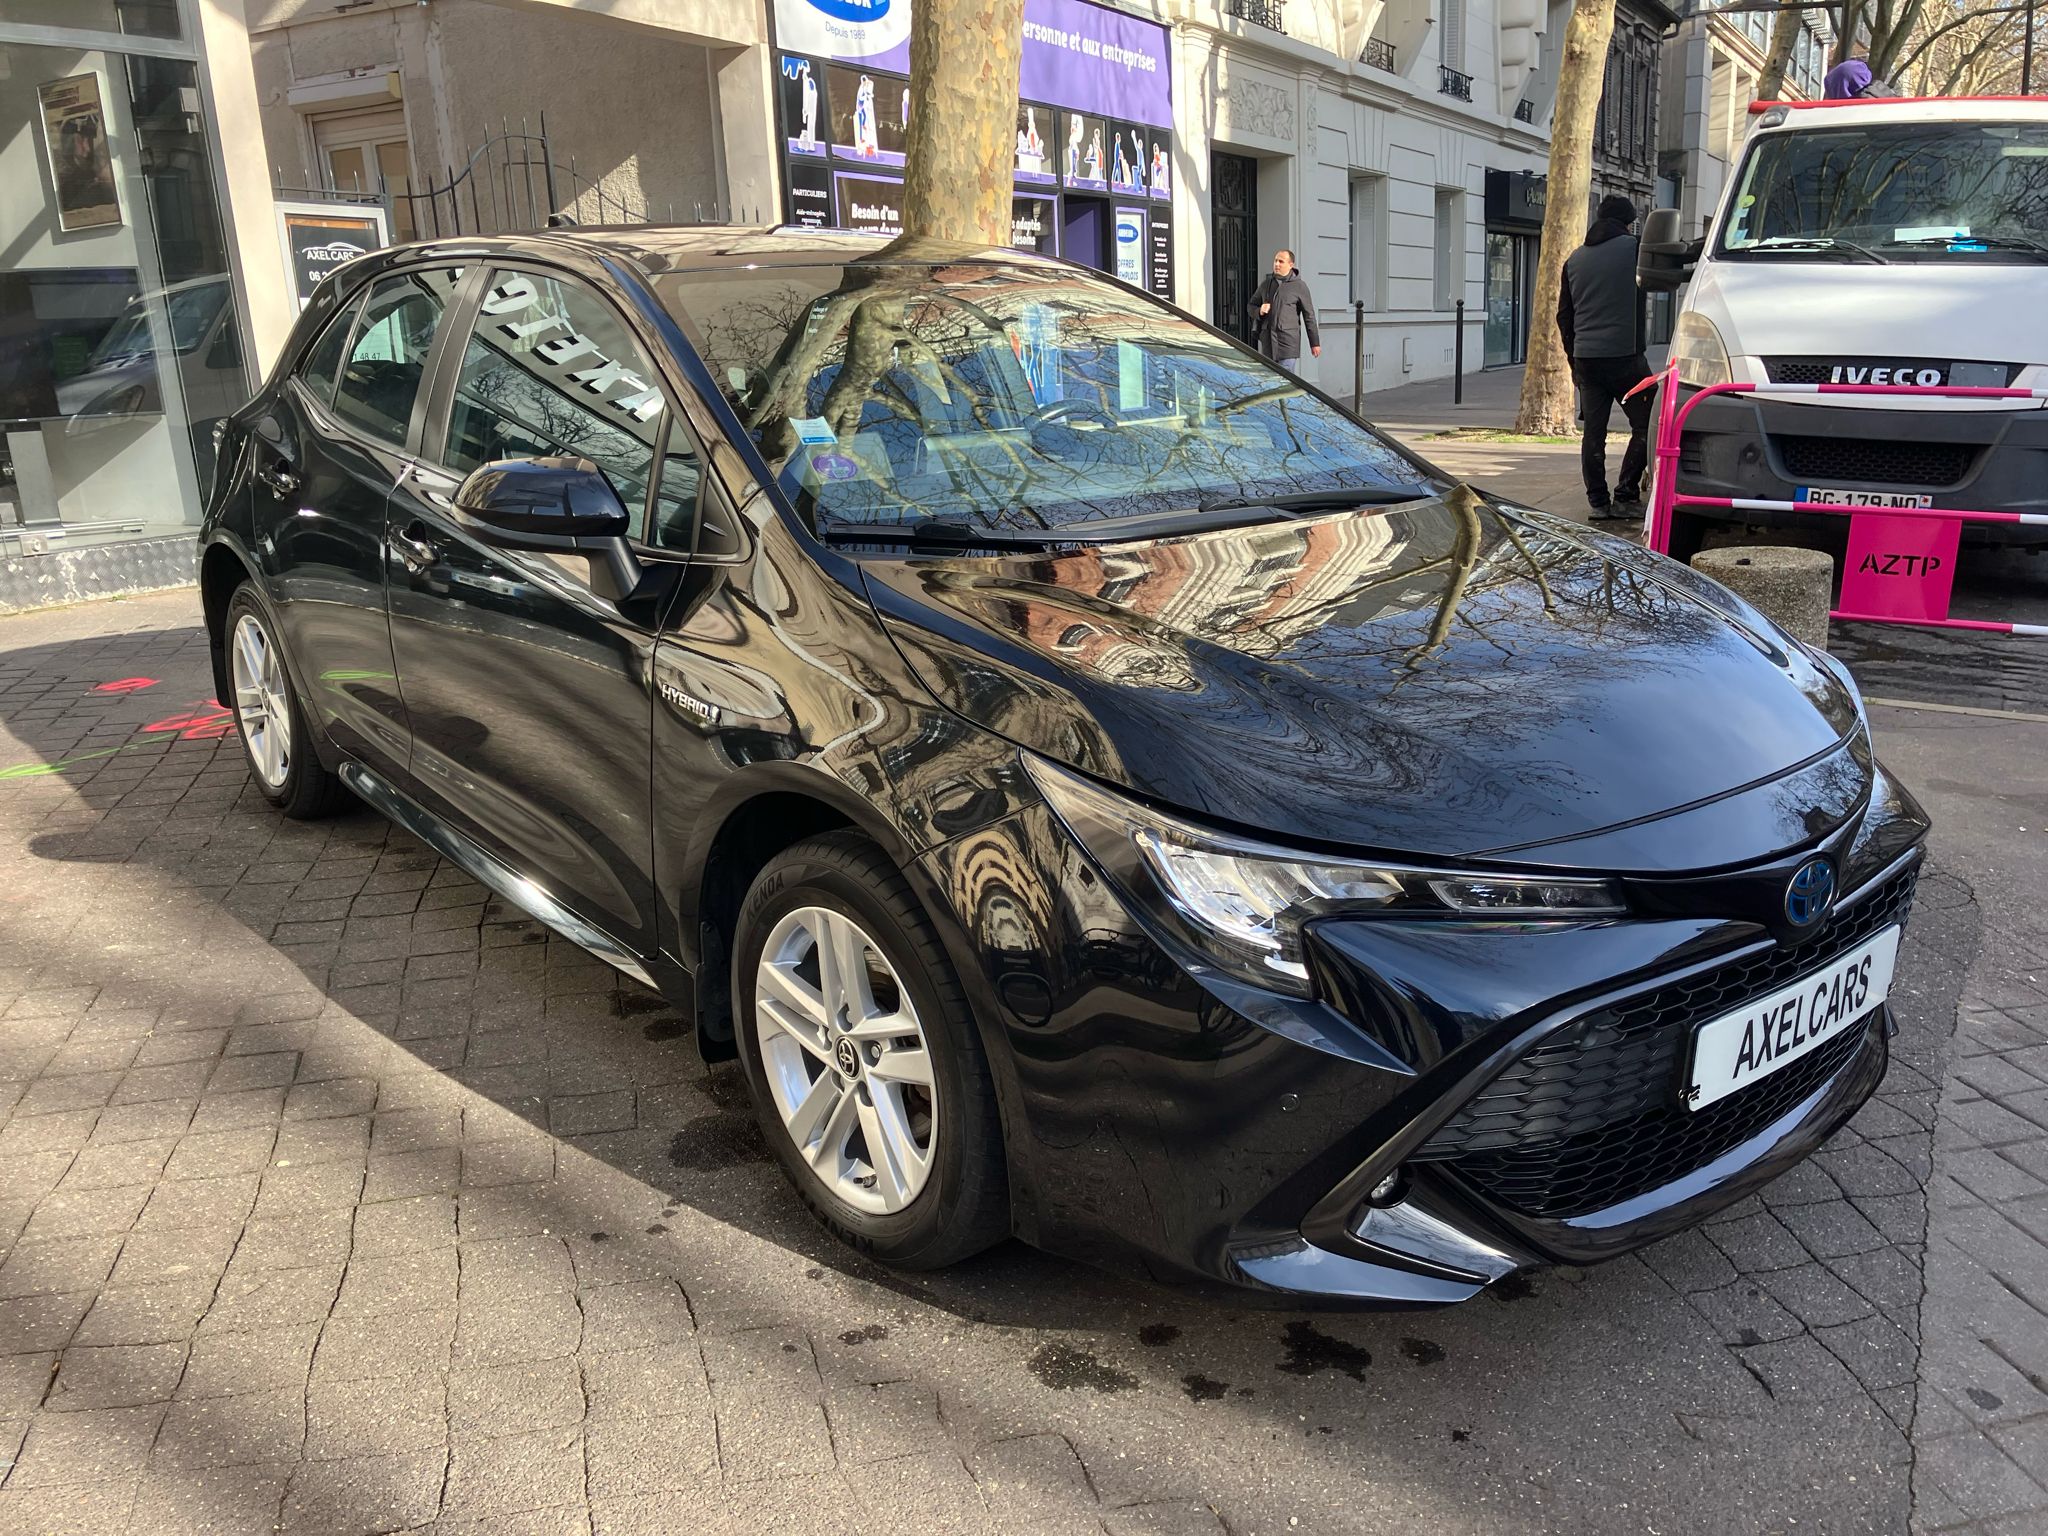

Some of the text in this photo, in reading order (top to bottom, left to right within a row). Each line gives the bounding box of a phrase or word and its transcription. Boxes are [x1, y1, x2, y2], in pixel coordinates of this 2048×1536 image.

[825, 21, 865, 40] Depuis 1989
[1022, 20, 1156, 72] ersonne et aux entreprises
[792, 188, 828, 199] PARTICULIERS
[851, 203, 899, 221] Besoin d'un
[308, 271, 321, 281] 06
[1830, 366, 1941, 387] IVECO
[1858, 553, 1941, 577] AZTP
[661, 683, 709, 719] HYBRID
